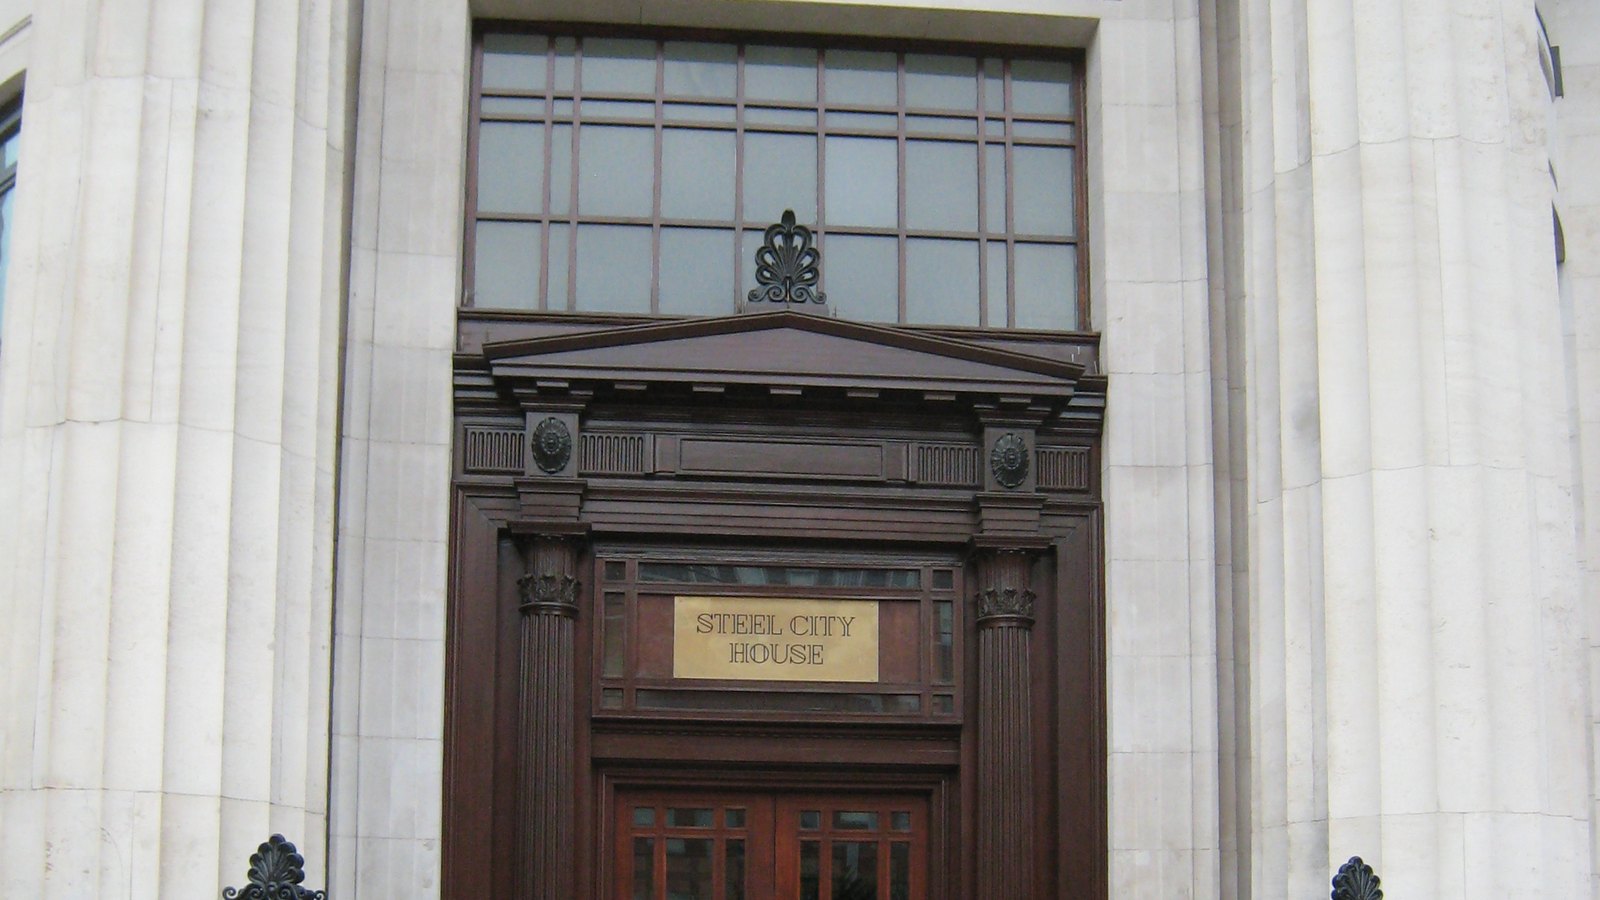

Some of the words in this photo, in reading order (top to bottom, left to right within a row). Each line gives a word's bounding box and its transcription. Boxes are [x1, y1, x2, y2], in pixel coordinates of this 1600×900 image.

[696, 613, 783, 635] STEEL
[790, 615, 856, 637] CITY
[729, 642, 824, 665] HOUSE
